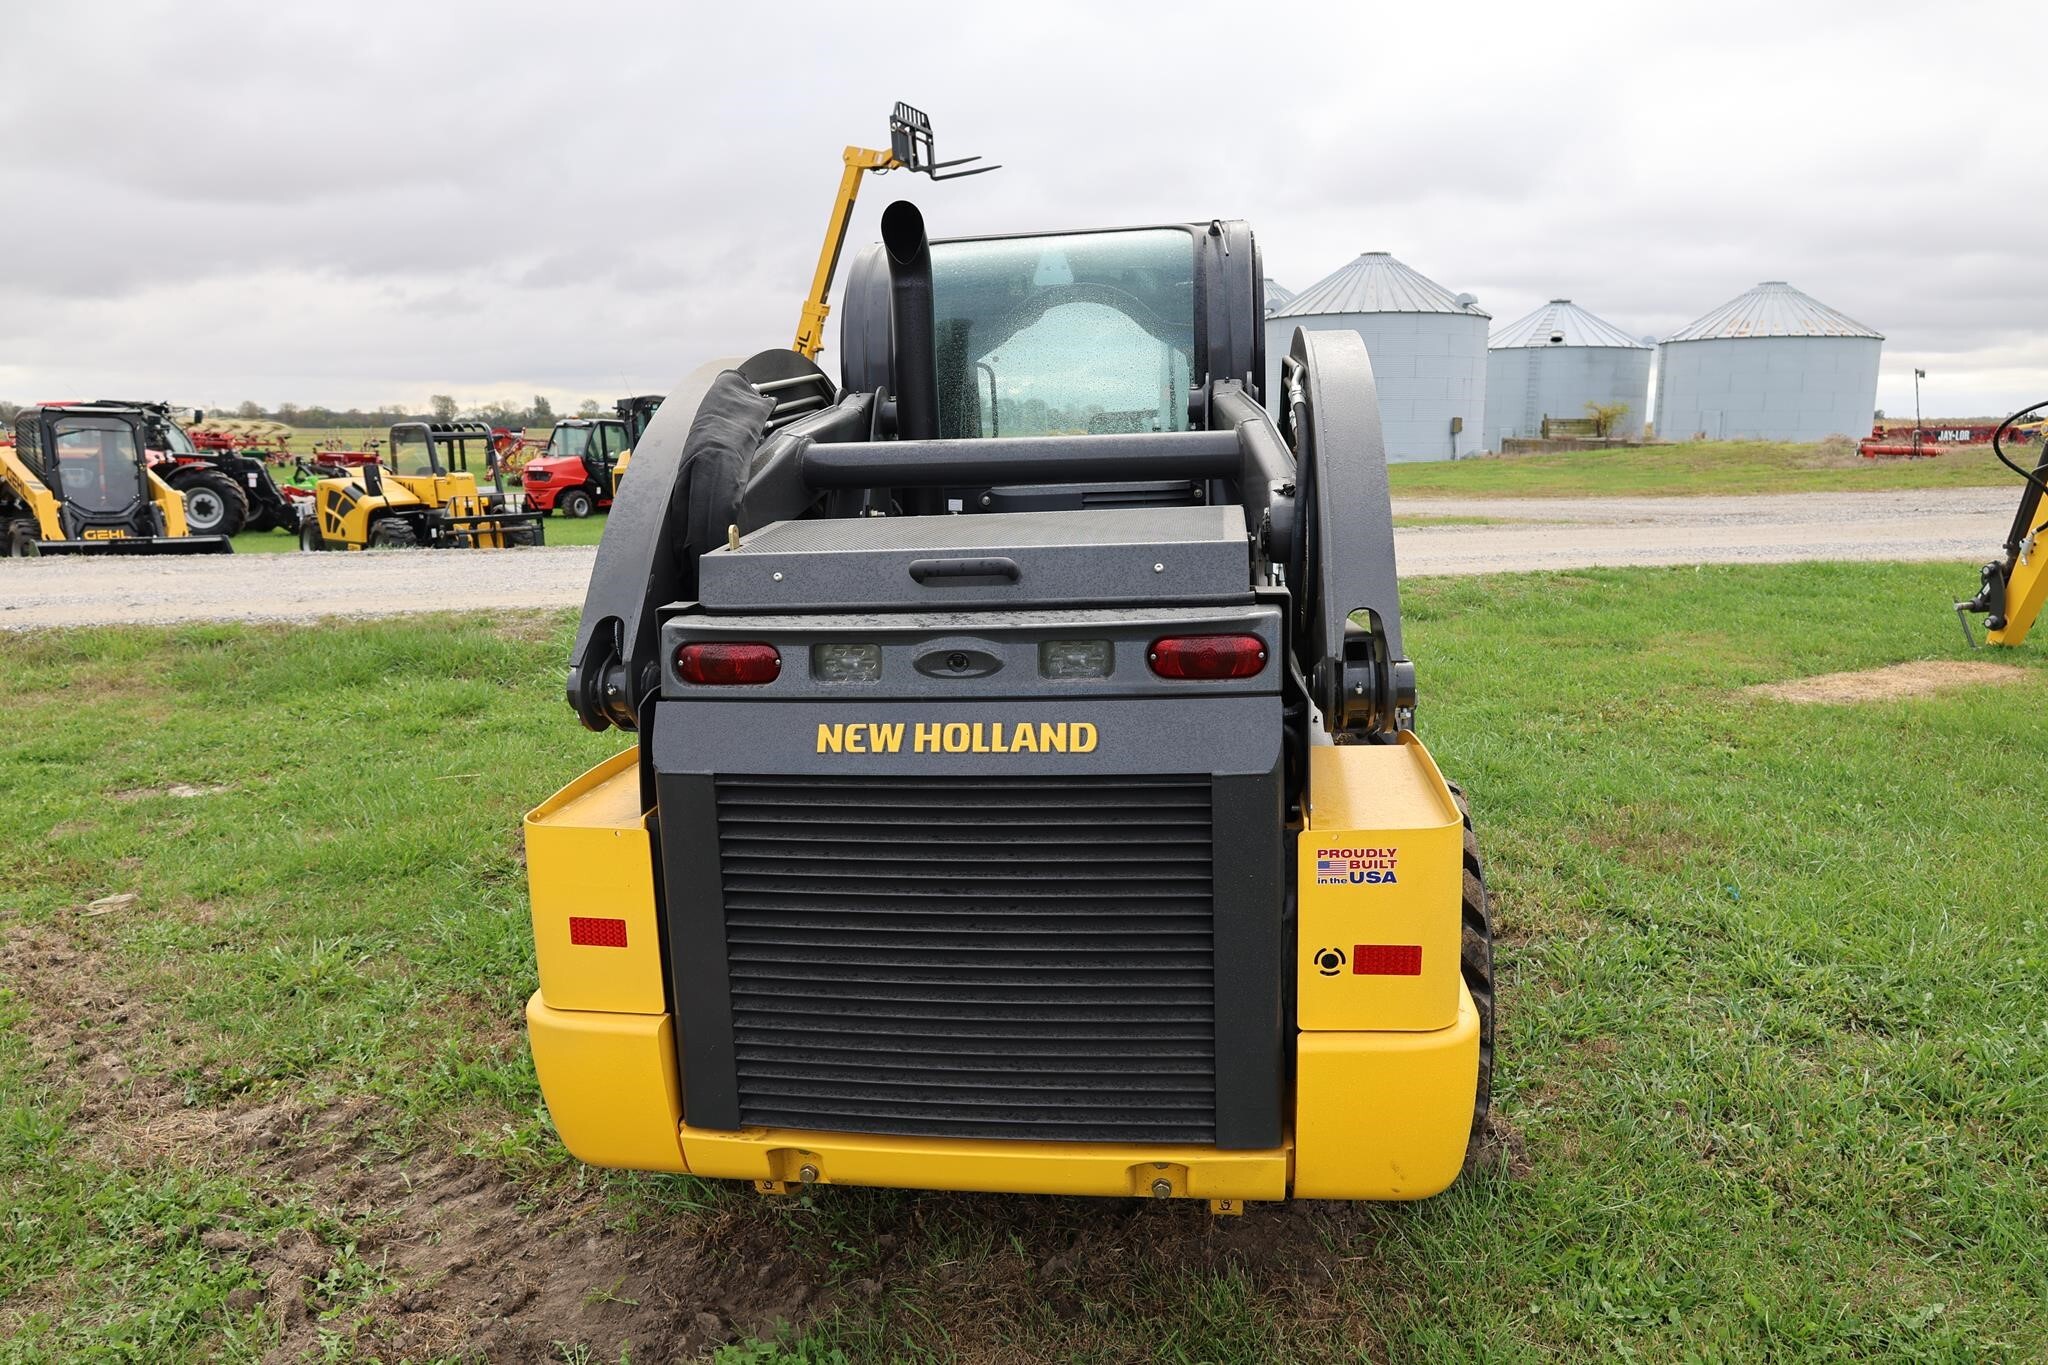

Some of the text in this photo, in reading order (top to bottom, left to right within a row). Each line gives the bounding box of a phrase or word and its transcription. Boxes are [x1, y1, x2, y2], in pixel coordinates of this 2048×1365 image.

[1938, 430, 1970, 441] JAY-LOR
[84, 529, 132, 541] GEHL
[816, 722, 1098, 753] NEW HOLLAND
[1317, 848, 1397, 858] PROUDLY
[1349, 860, 1397, 869] BUILT
[1349, 871, 1397, 883] USA
